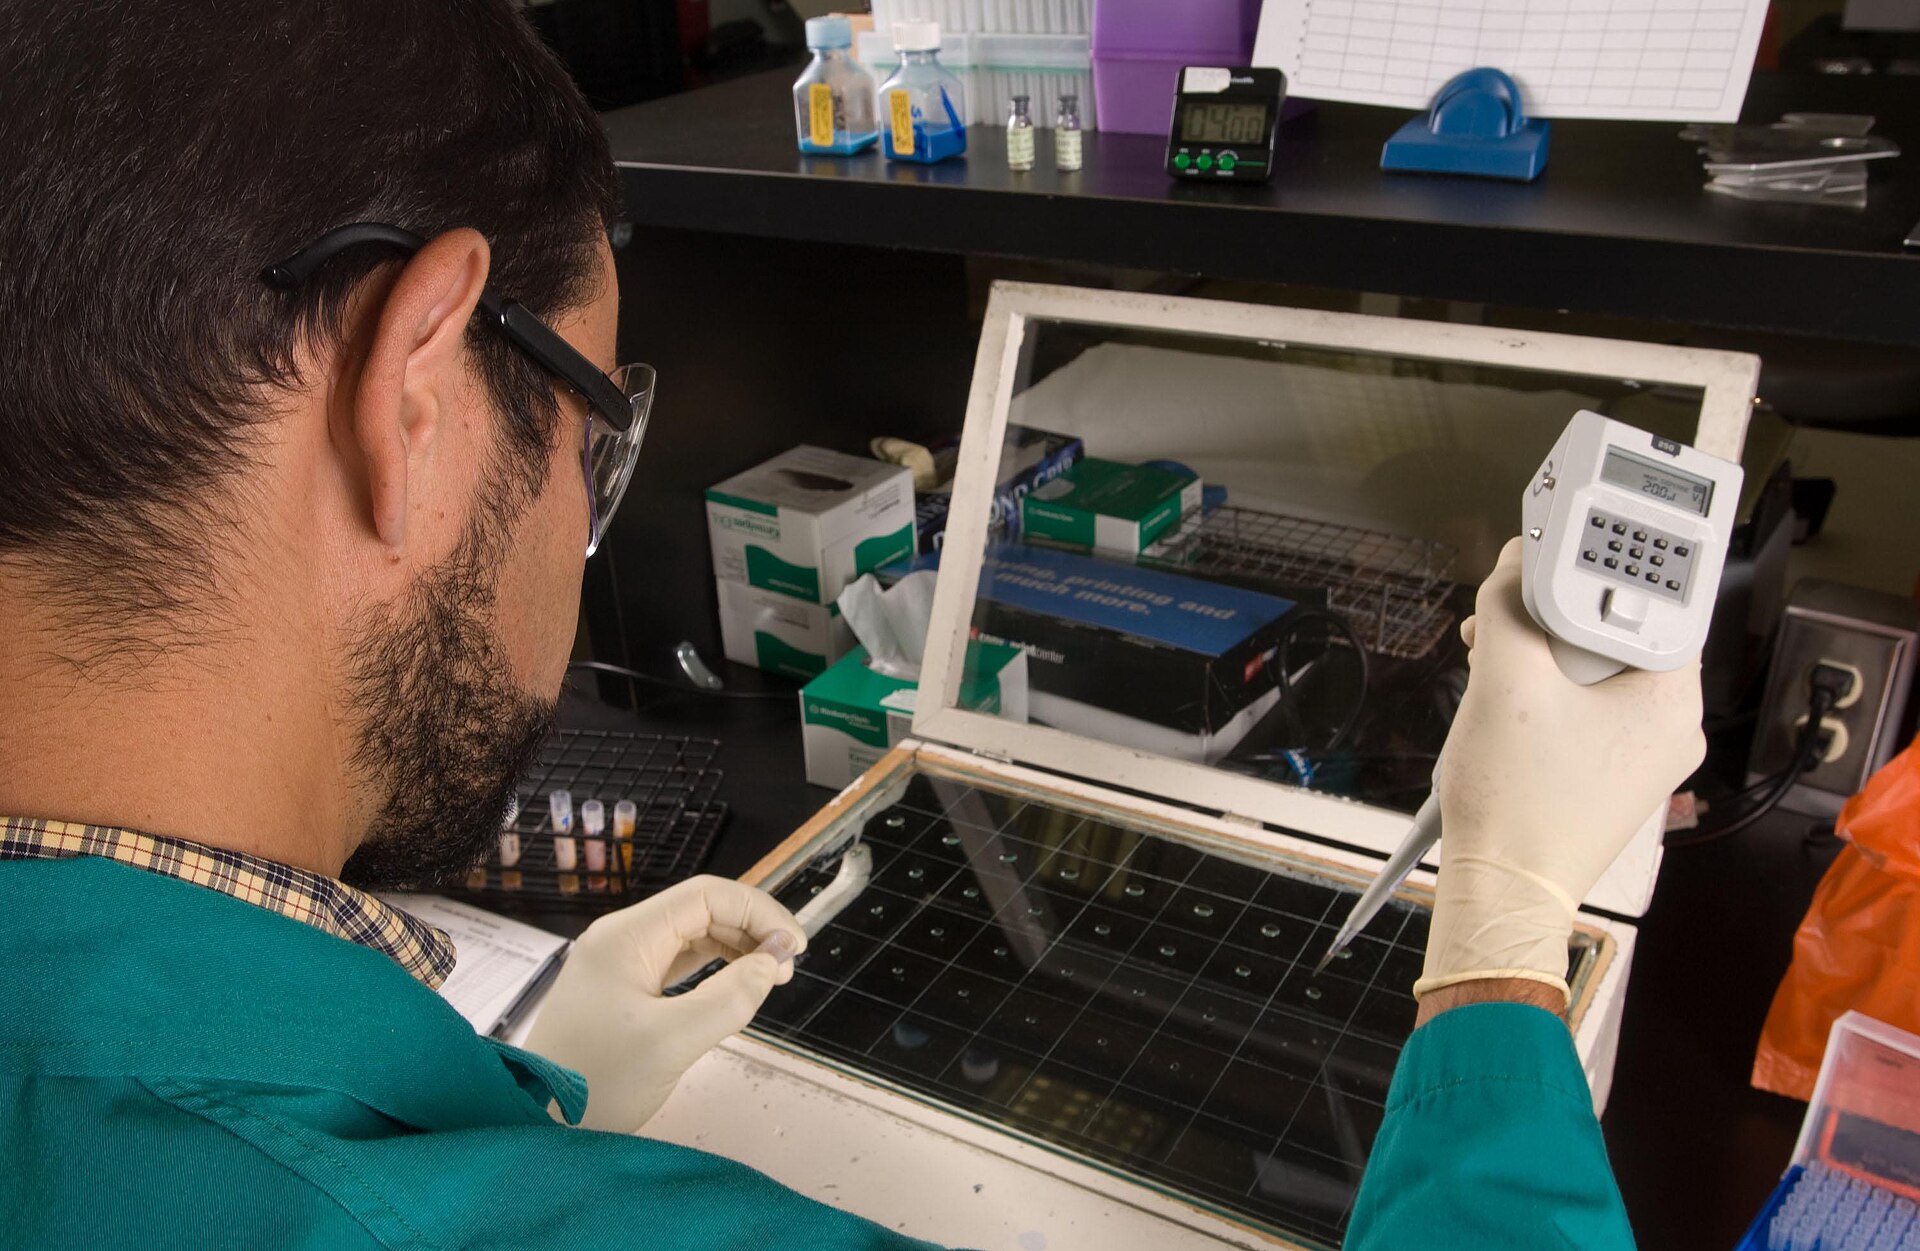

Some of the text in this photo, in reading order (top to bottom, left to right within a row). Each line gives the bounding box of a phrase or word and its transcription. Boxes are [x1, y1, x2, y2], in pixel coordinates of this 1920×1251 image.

[996, 573, 1070, 595] much
[1062, 575, 1174, 606] printing
[1178, 600, 1236, 620] and
